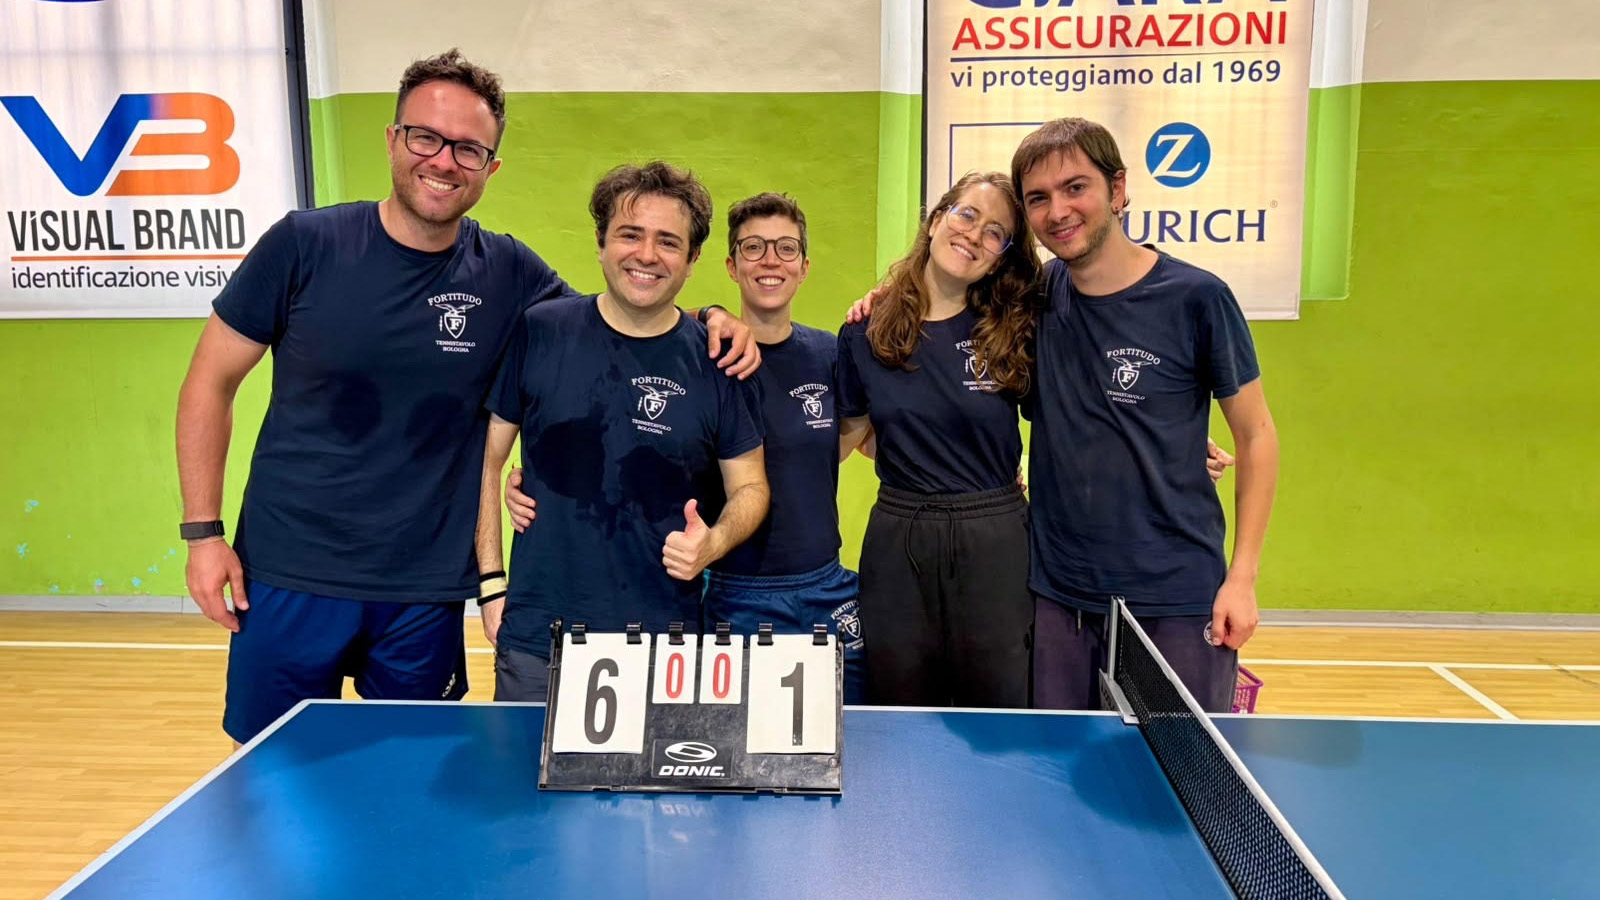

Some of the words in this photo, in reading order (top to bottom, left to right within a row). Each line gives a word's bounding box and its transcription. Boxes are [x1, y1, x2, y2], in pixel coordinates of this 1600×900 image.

[951, 11, 1287, 50] ASSICURAZIONI
[950, 65, 972, 87] vi
[982, 63, 1154, 93] proteggiamo
[1163, 61, 1201, 84] dal
[1212, 59, 1281, 83] 1969
[133, 209, 246, 251] BRAND
[1122, 209, 1267, 244] URICH
[12, 266, 180, 289] identificazione
[184, 265, 236, 287] visiv
[427, 292, 482, 306] FORTITUDO
[449, 317, 463, 331] F
[1106, 347, 1161, 365] FORTITUDO
[631, 376, 686, 395] FORTITUDO
[1121, 371, 1135, 383] F
[789, 383, 829, 398] FORTITUDO
[648, 400, 662, 412] F
[584, 657, 620, 745] 6
[665, 652, 685, 699] 0
[712, 652, 731, 699] 0
[780, 661, 804, 746] 1
